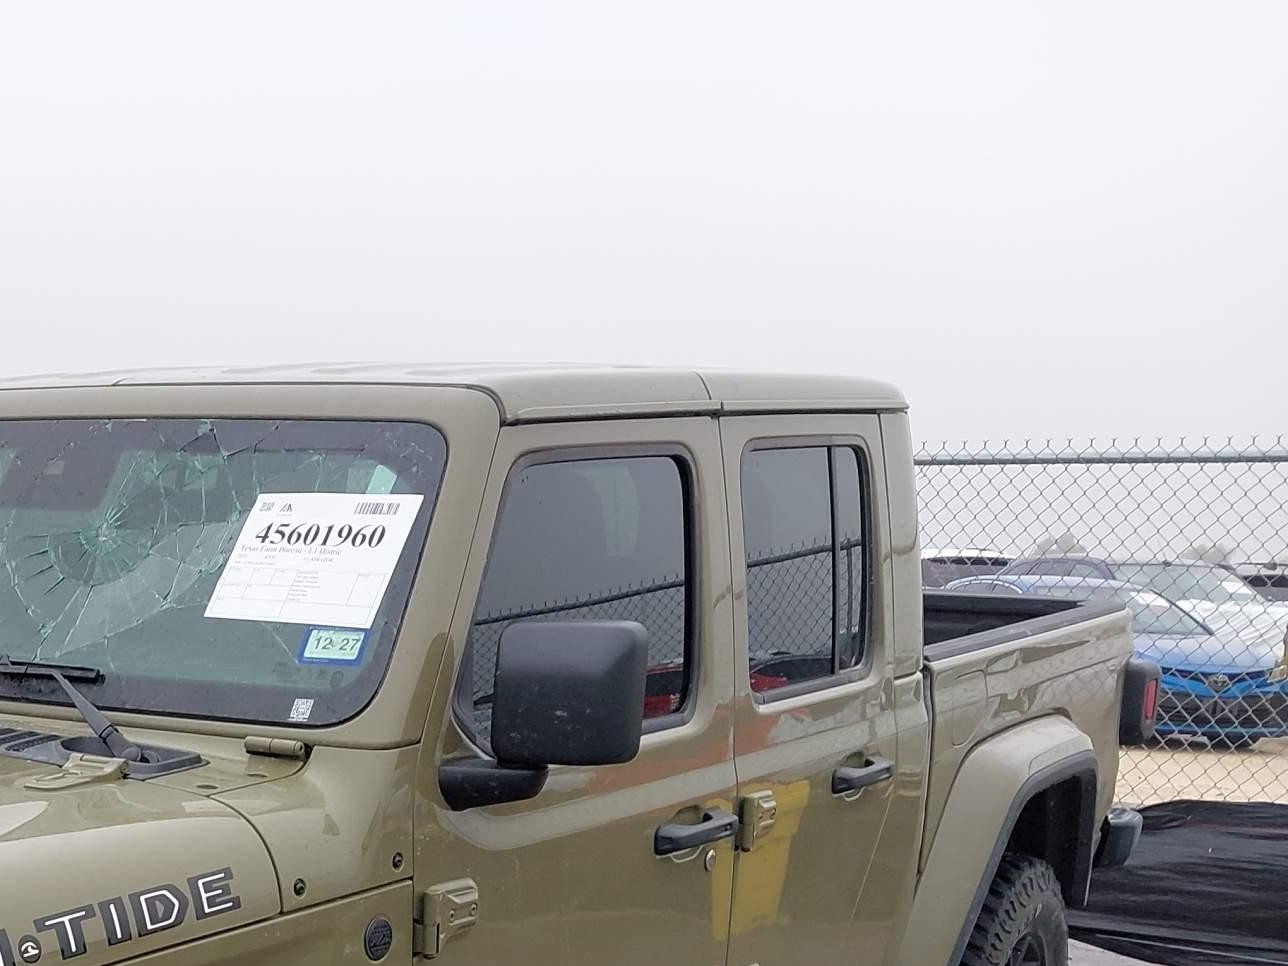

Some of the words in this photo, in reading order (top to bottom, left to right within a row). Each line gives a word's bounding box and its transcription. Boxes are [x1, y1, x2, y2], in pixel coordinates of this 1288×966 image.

[255, 522, 386, 548] 45601960
[314, 636, 331, 650] 12
[339, 638, 361, 651] 27
[33, 867, 241, 960] TIDE
